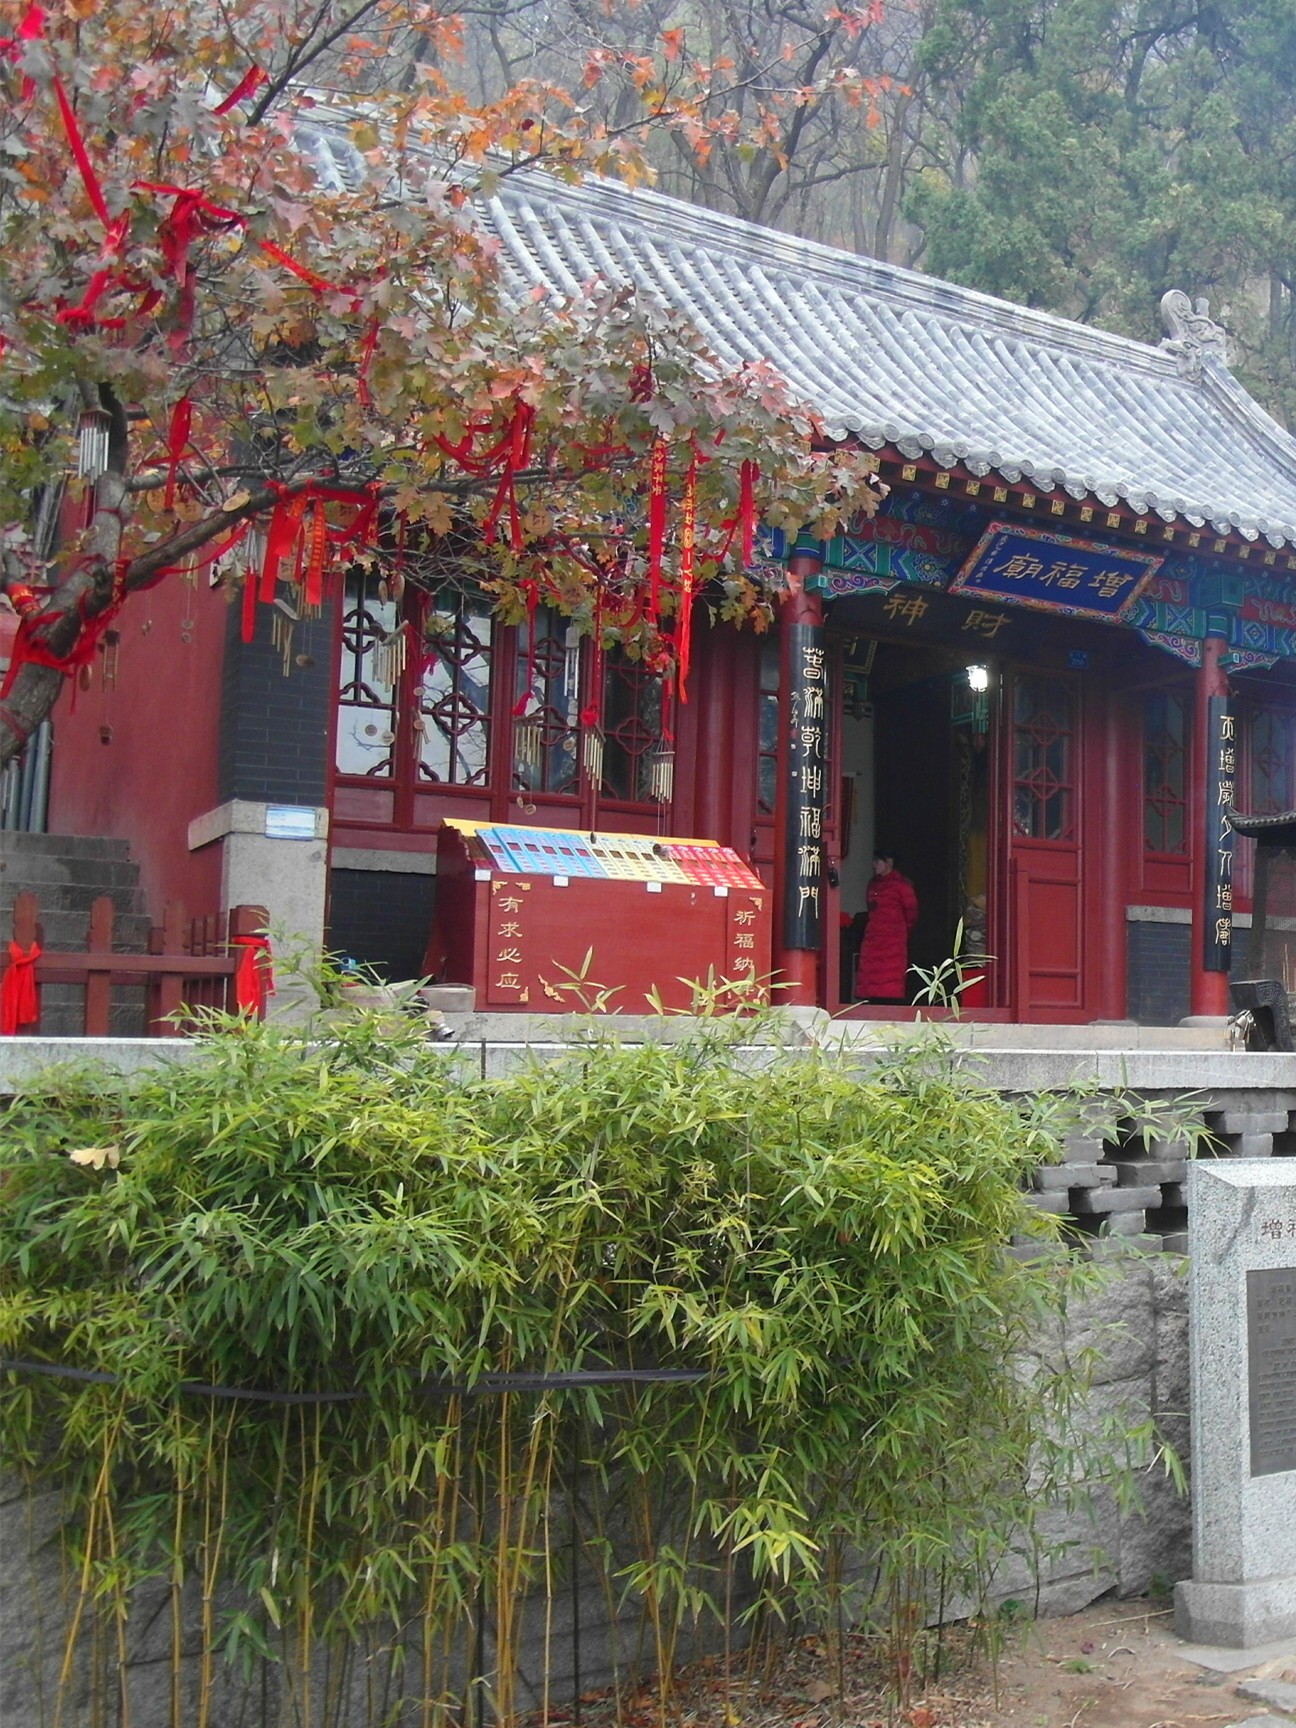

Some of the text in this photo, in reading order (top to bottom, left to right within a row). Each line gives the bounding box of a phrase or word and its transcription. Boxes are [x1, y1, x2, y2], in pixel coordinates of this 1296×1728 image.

[993, 553, 1133, 598] 增福廟
[496, 896, 523, 989] 有求必应
